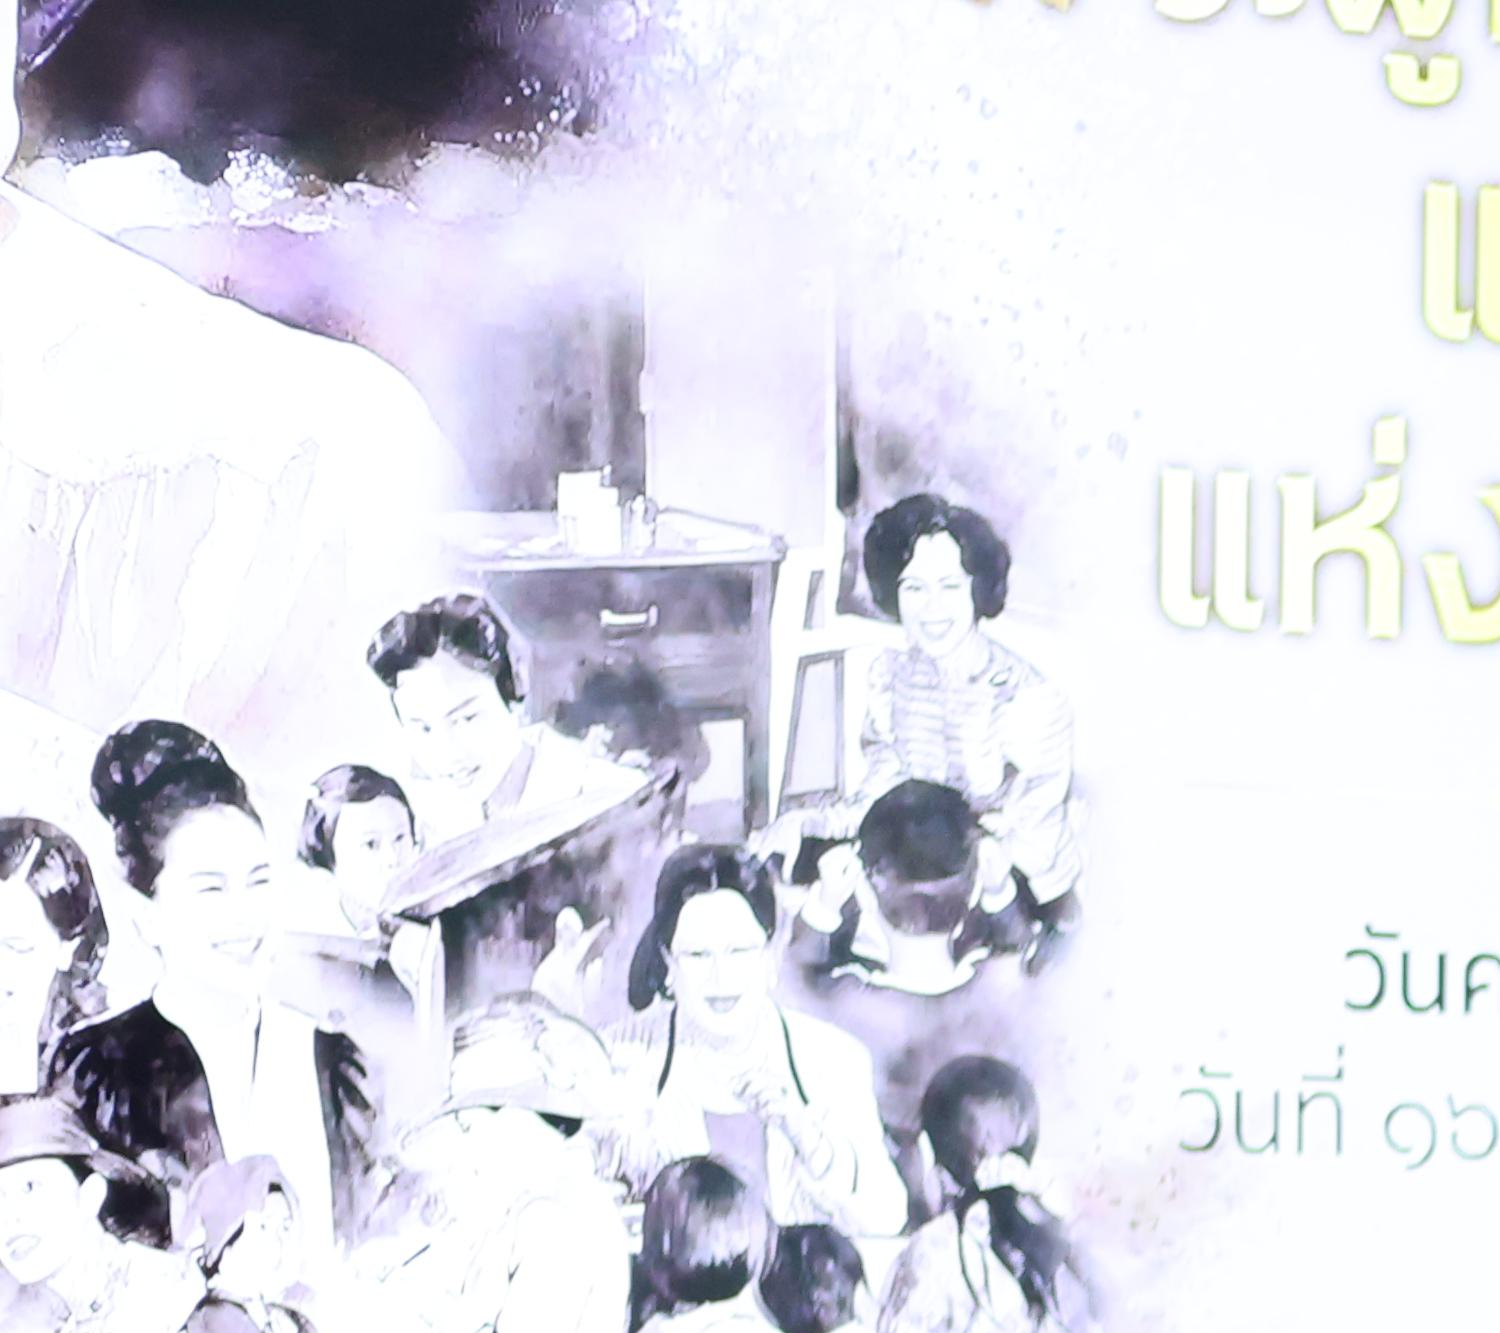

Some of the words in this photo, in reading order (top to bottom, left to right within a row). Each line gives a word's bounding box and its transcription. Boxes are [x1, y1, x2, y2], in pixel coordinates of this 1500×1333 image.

[1177, 1044, 1348, 1159] วันที่
[1380, 1089, 1500, 1172] ๑๖
